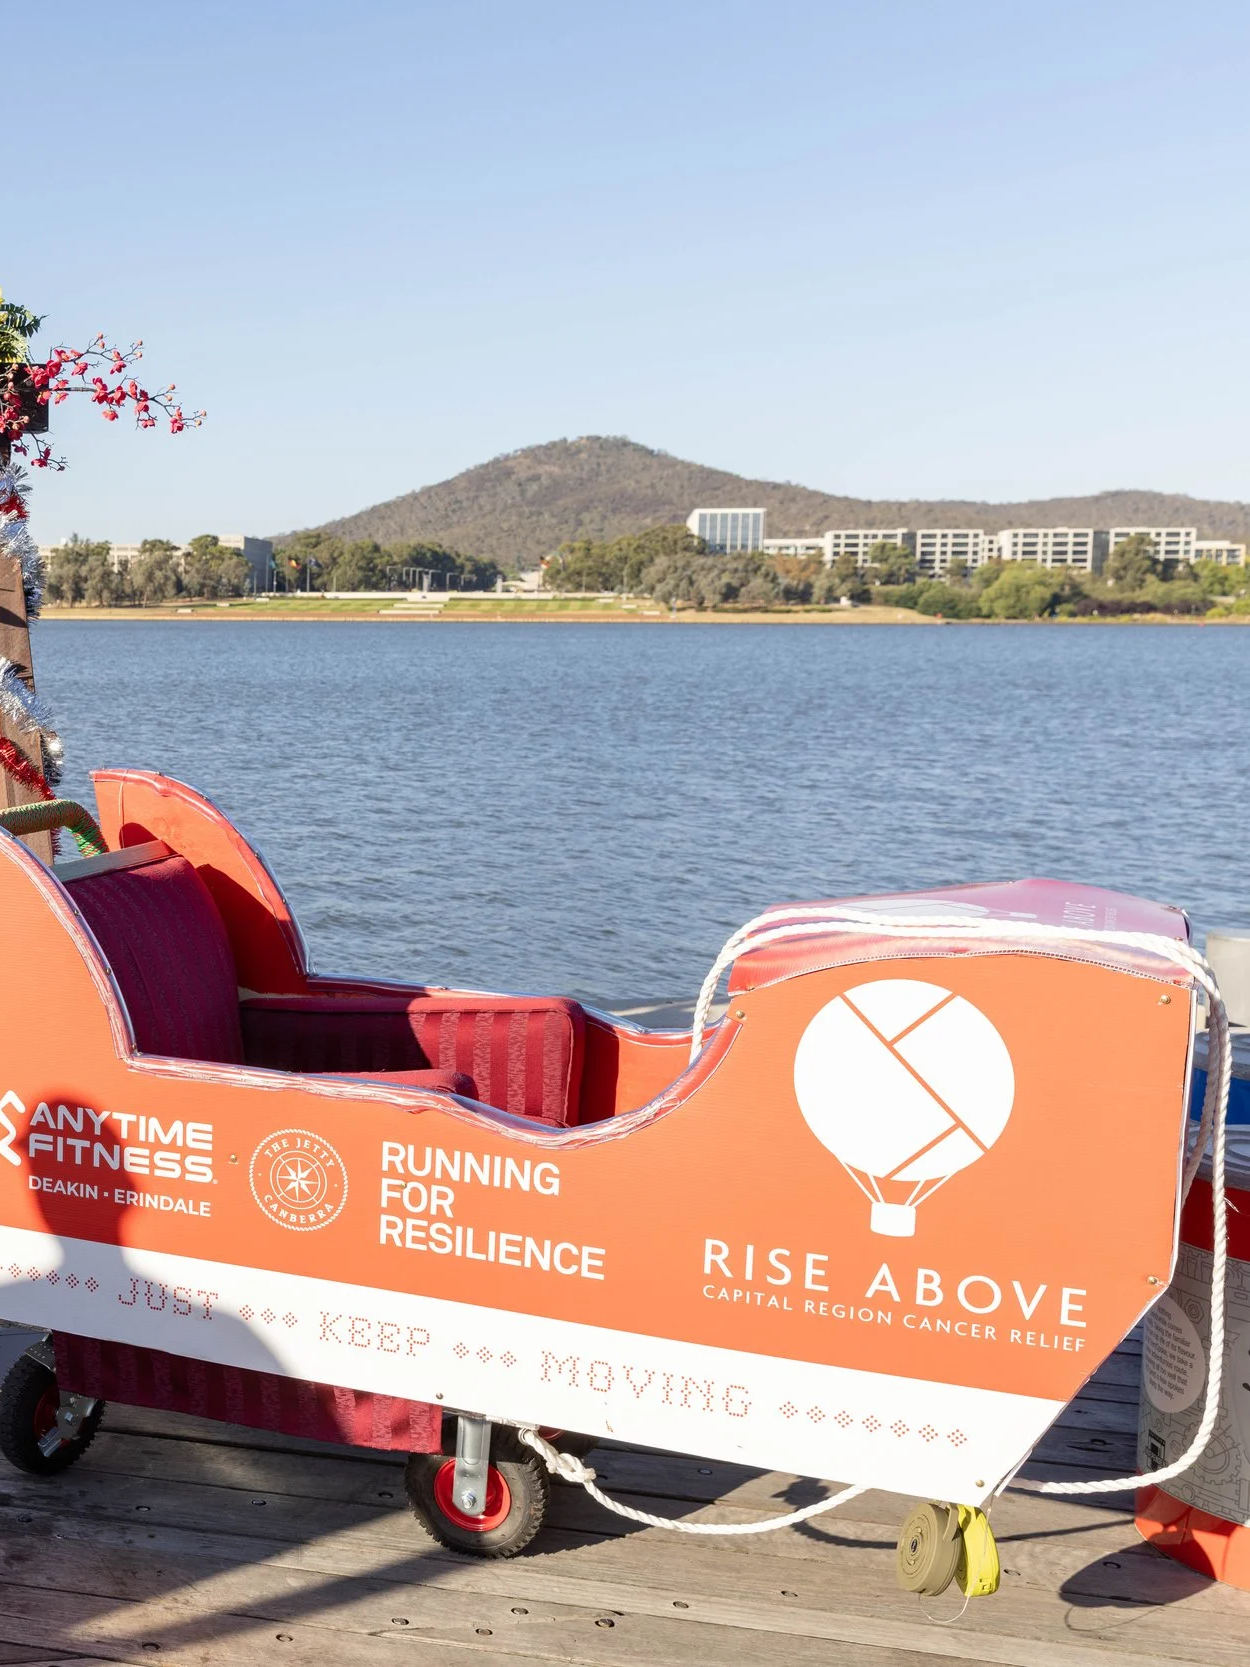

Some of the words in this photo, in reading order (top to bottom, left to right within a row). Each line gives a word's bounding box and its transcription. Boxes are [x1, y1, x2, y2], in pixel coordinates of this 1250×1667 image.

[30, 1102, 213, 1151] ANYTIME
[264, 1138, 290, 1158] THE
[295, 1137, 335, 1168] JETTY
[29, 1132, 214, 1184] FITNESS
[381, 1141, 560, 1196] RUNNING
[29, 1175, 98, 1200] DEAKIN
[114, 1188, 212, 1217] ERINDALE
[264, 1194, 334, 1224] CANBERRA
[381, 1177, 455, 1218] FOR
[379, 1214, 607, 1281] RESILIENCE
[703, 1238, 830, 1292] RISE
[864, 1262, 1088, 1328] ABOVE
[702, 1284, 793, 1311] CAPITAL
[804, 1299, 893, 1326] REGION
[902, 1313, 998, 1341] CANCER
[1010, 1328, 1087, 1353] RELIEF
[118, 1277, 219, 1320] JUST
[319, 1310, 431, 1357] KEEP
[540, 1350, 753, 1418] MOVING
